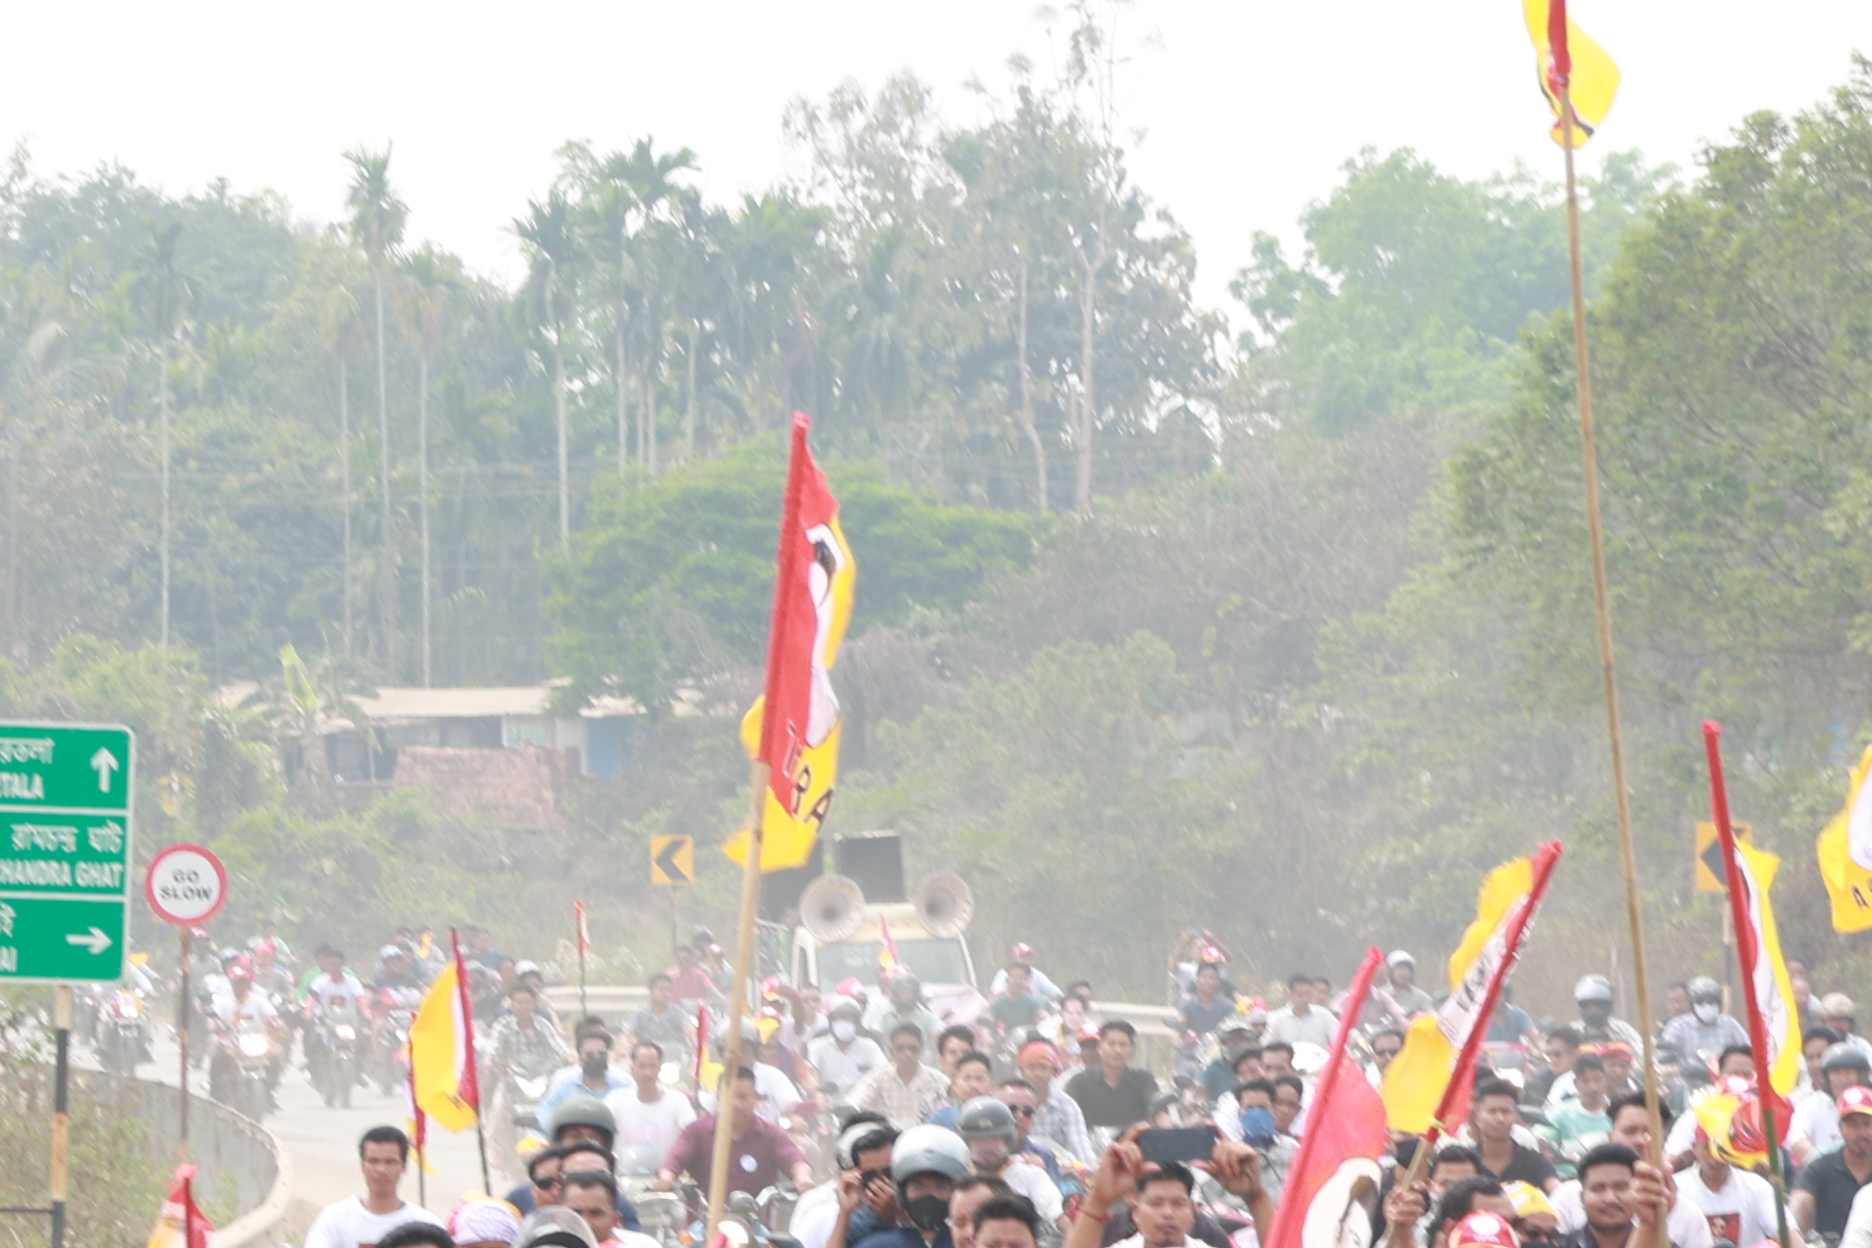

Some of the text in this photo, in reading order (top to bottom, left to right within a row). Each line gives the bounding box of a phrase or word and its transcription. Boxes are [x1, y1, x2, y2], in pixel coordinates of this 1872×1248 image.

[0, 771, 45, 799] TALA
[0, 859, 123, 888] HANDRA GHAT
[172, 868, 200, 884] GO
[160, 885, 213, 901] SLOW
